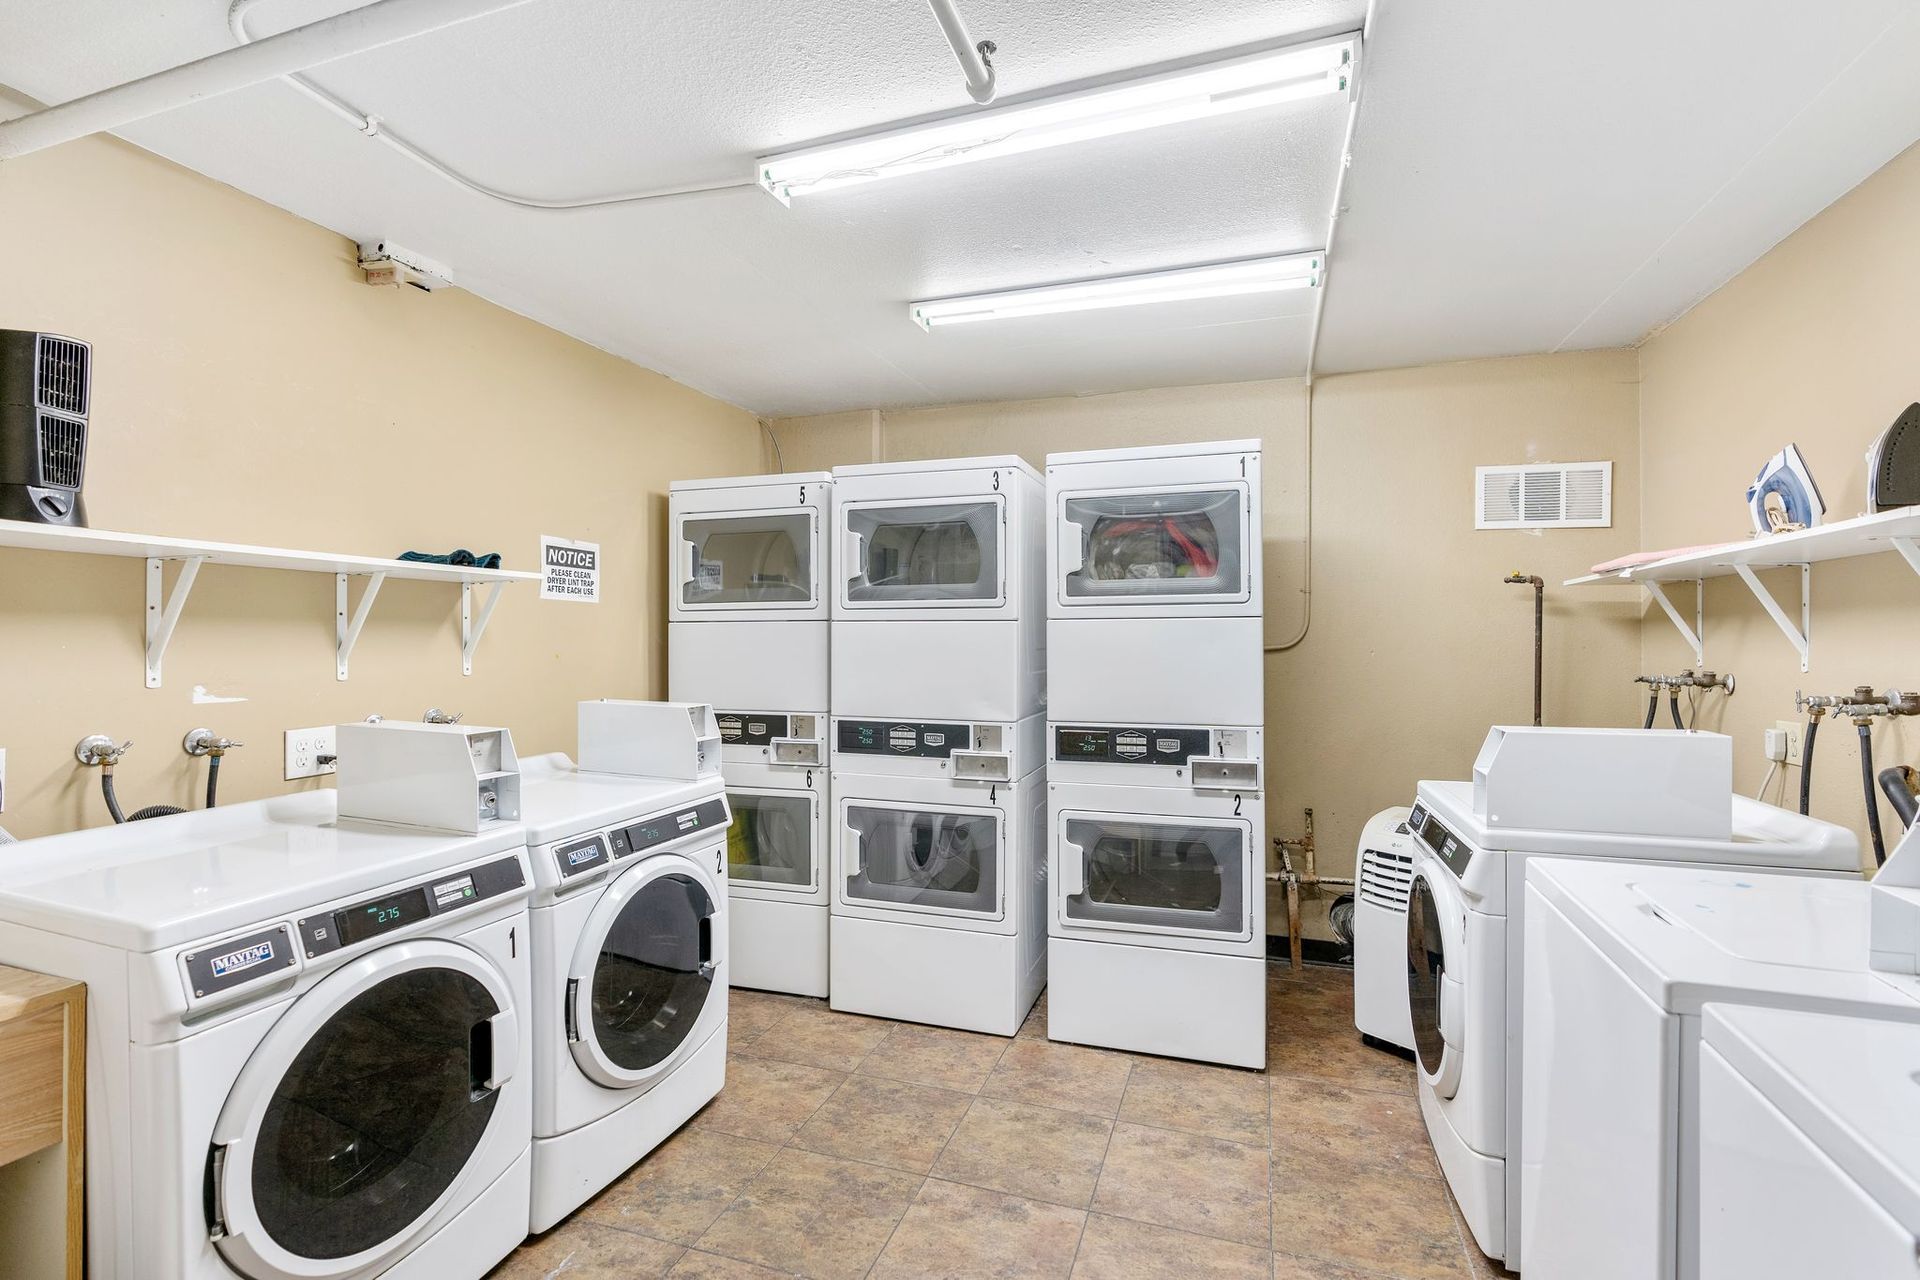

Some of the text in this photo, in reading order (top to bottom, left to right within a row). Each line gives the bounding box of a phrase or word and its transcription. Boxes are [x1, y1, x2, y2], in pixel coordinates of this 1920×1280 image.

[1240, 456, 1246, 478] 1
[993, 470, 999, 491] 3
[800, 486, 806, 504] 5
[548, 548, 594, 567] NOTICE
[547, 576, 566, 585] DRYER
[551, 568, 592, 579] PLEASE CLEAN
[547, 585, 566, 593] AFTER
[806, 770, 812, 788] 6
[990, 784, 996, 805] 4
[1234, 794, 1241, 816] 2
[570, 845, 596, 861] MAYTAG
[716, 850, 722, 874] 2
[509, 926, 516, 958] 1
[214, 945, 270, 970] MAYTAG
